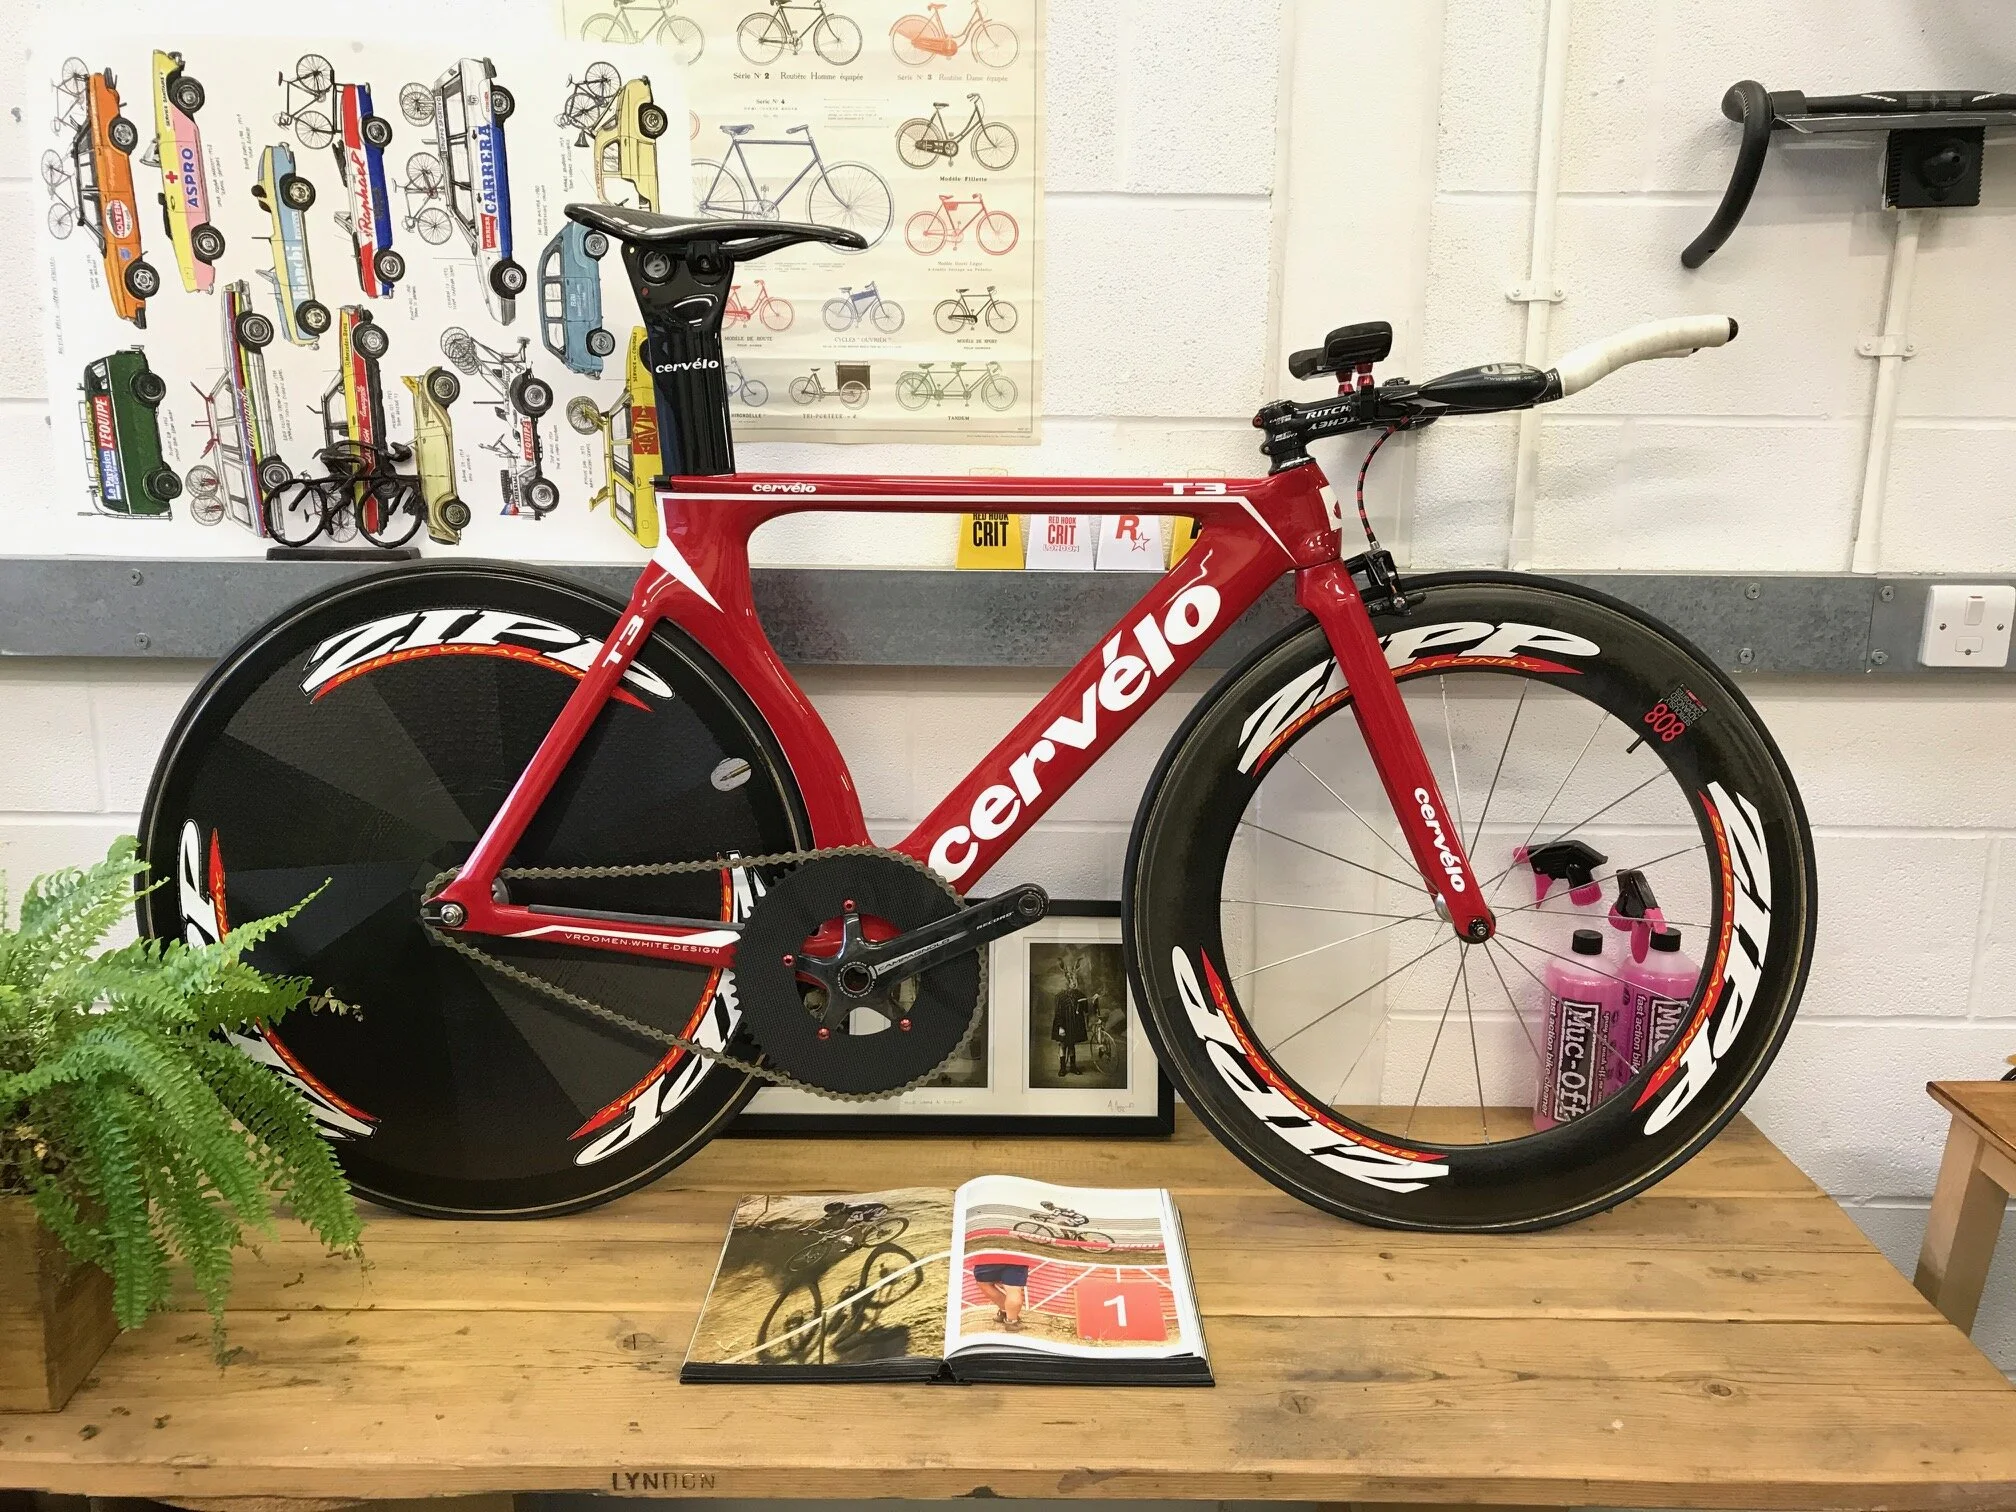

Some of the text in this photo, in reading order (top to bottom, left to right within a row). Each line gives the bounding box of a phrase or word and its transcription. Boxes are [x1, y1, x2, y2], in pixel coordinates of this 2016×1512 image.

[764, 72, 770, 80] 2
[181, 148, 199, 207] ASPRO
[478, 124, 497, 213] CARRERA
[655, 357, 719, 374] cervélo
[1306, 405, 1350, 420] RITCH
[103, 451, 116, 499] Le Parisien
[752, 482, 817, 493] cervélo
[1163, 483, 1226, 495] T3
[972, 521, 1009, 547] CRIT
[1047, 524, 1077, 546] CRIT
[1048, 516, 1077, 524] RED HOOK
[1115, 515, 1140, 540] R
[1043, 544, 1080, 553] LONDON
[299, 608, 676, 697] ZIPP
[602, 616, 645, 668] T3
[336, 644, 587, 684] SPEED WEAPON
[1267, 656, 1540, 752] SPEED EAPONRY
[1664, 698, 1693, 727] SERIOUSLY
[1670, 692, 1698, 721] ADVANCED
[1676, 687, 1704, 717] COMPOSITES
[928, 584, 1221, 883] cervélo
[1644, 703, 1686, 742] 808
[1413, 787, 1466, 894] cervélo
[976, 911, 1014, 931] RECORD
[877, 938, 950, 973] CAMPAGNOLO
[1643, 781, 1772, 1136] ZIPP
[1656, 814, 1733, 1081] SPEED WEAPONRY
[1632, 994, 1647, 1072] fast action bik
[1172, 946, 1449, 1194] ZIPP
[1215, 983, 1418, 1160] SPEED WEAPONRY
[1541, 995, 1558, 1117] fast action bike cleaner
[1560, 1007, 1593, 1118] Muc-Off
[1103, 1294, 1128, 1329] 1
